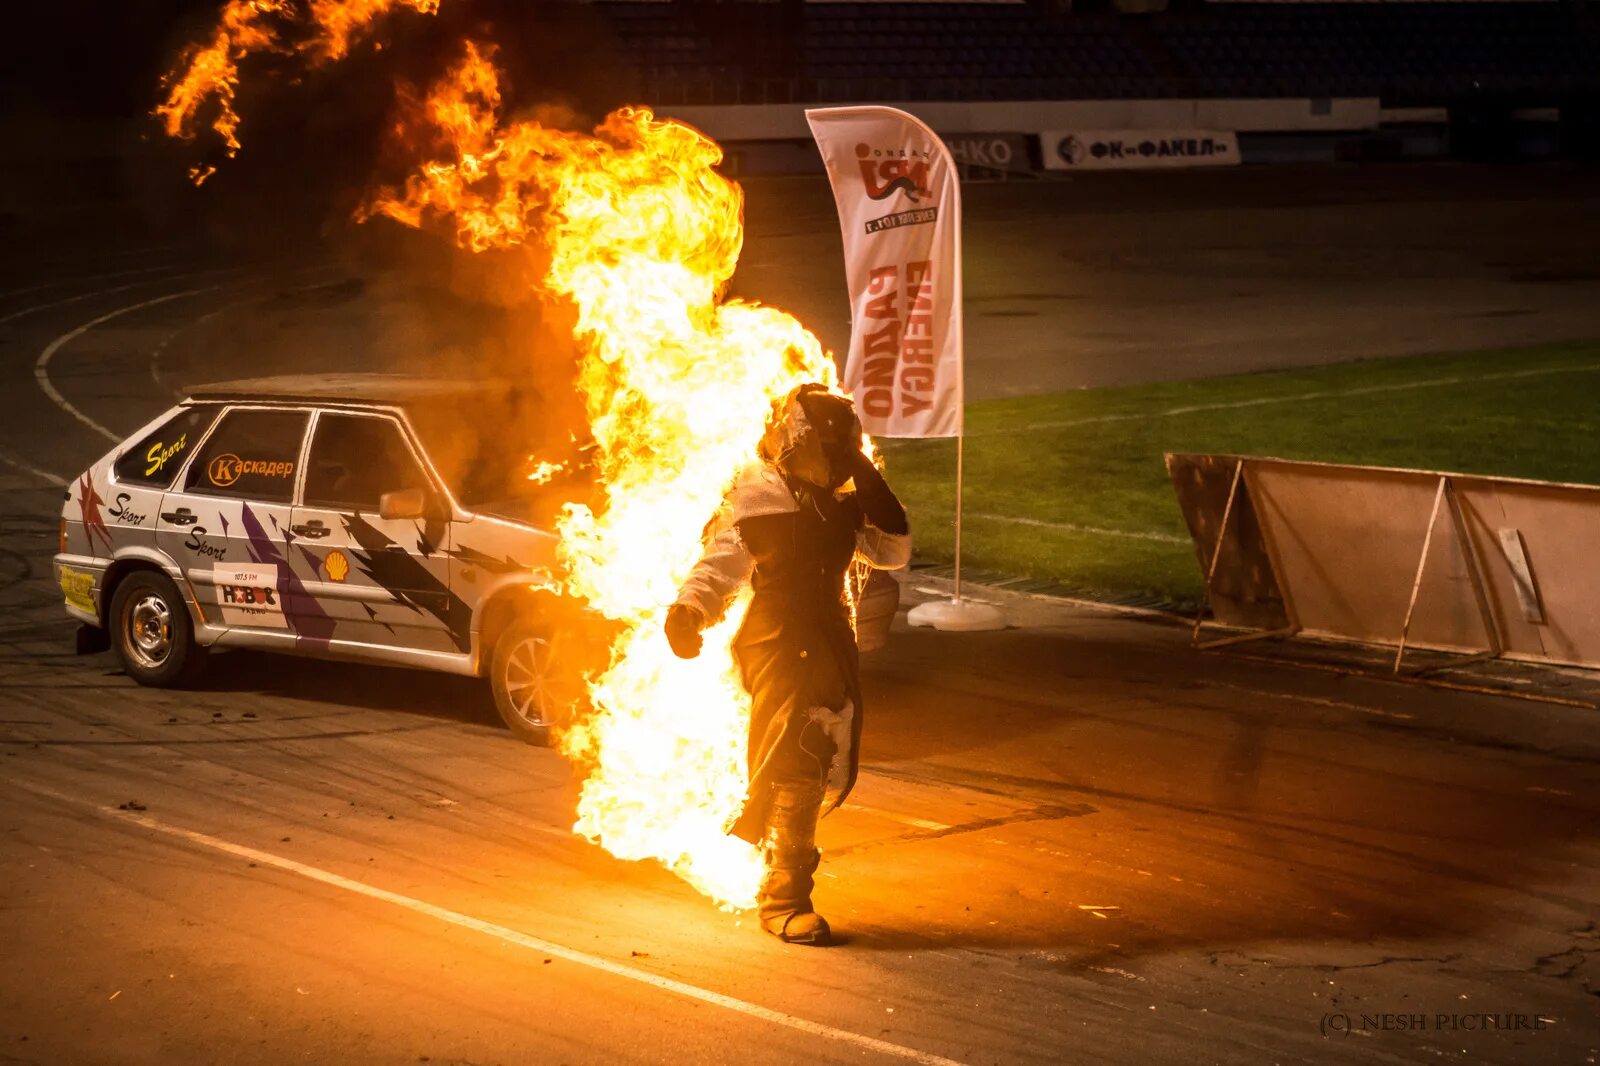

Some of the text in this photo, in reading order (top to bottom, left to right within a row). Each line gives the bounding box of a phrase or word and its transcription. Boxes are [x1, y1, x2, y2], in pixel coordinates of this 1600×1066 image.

[145, 433, 187, 476] Sport
[211, 457, 294, 482] Каскадер
[108, 492, 147, 526] Sport
[184, 526, 227, 561] Sport
[234, 573, 248, 581] 107.5
